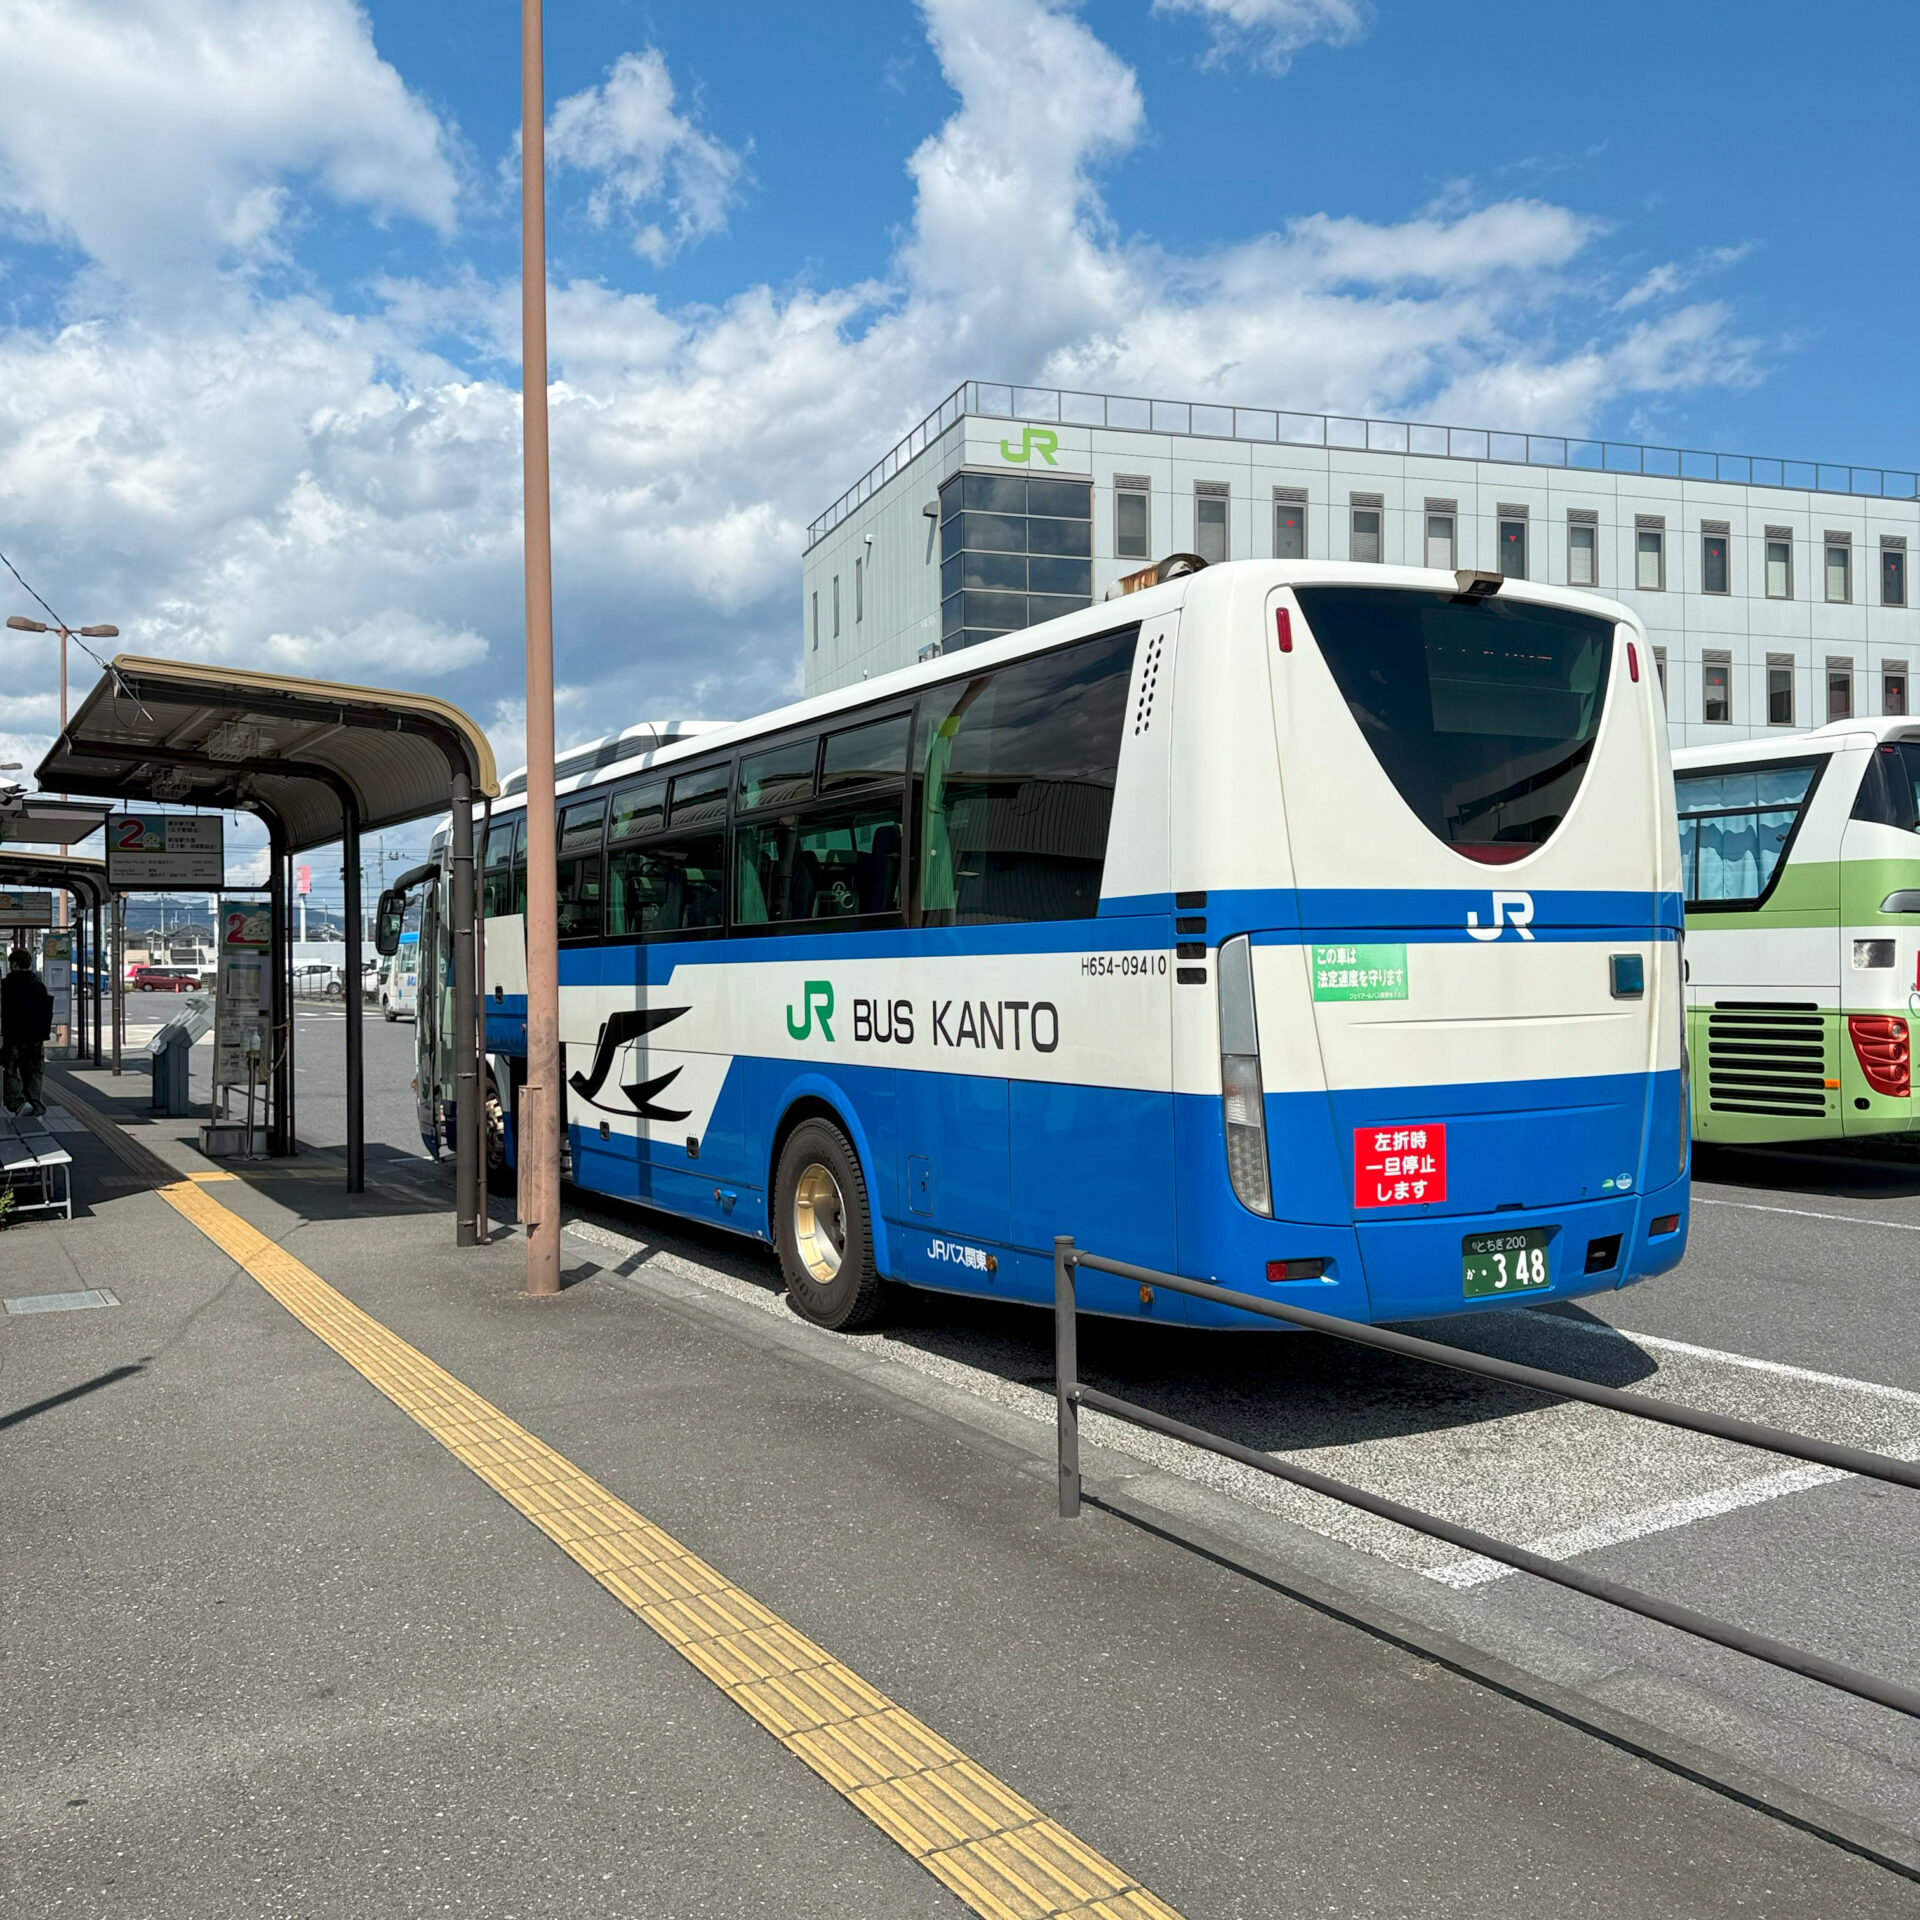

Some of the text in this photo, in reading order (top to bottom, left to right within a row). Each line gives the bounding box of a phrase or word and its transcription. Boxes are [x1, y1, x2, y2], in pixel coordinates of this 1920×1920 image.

[1001, 428, 1058, 465] JR
[118, 819, 145, 848] 2
[1465, 891, 1535, 941] JR
[227, 913, 269, 944] 2
[1081, 955, 1166, 976] H654-09410
[1317, 947, 1356, 965] この車は
[1317, 968, 1403, 989] 法定速度を守ります
[786, 980, 1059, 1053] JR BUS KANTO
[1374, 1130, 1427, 1152] 左折時
[1365, 1154, 1437, 1176] 一旦停止
[1377, 1179, 1428, 1202] します
[926, 1239, 988, 1272] JRバス関東
[1477, 1236, 1526, 1253] とちぎ 200
